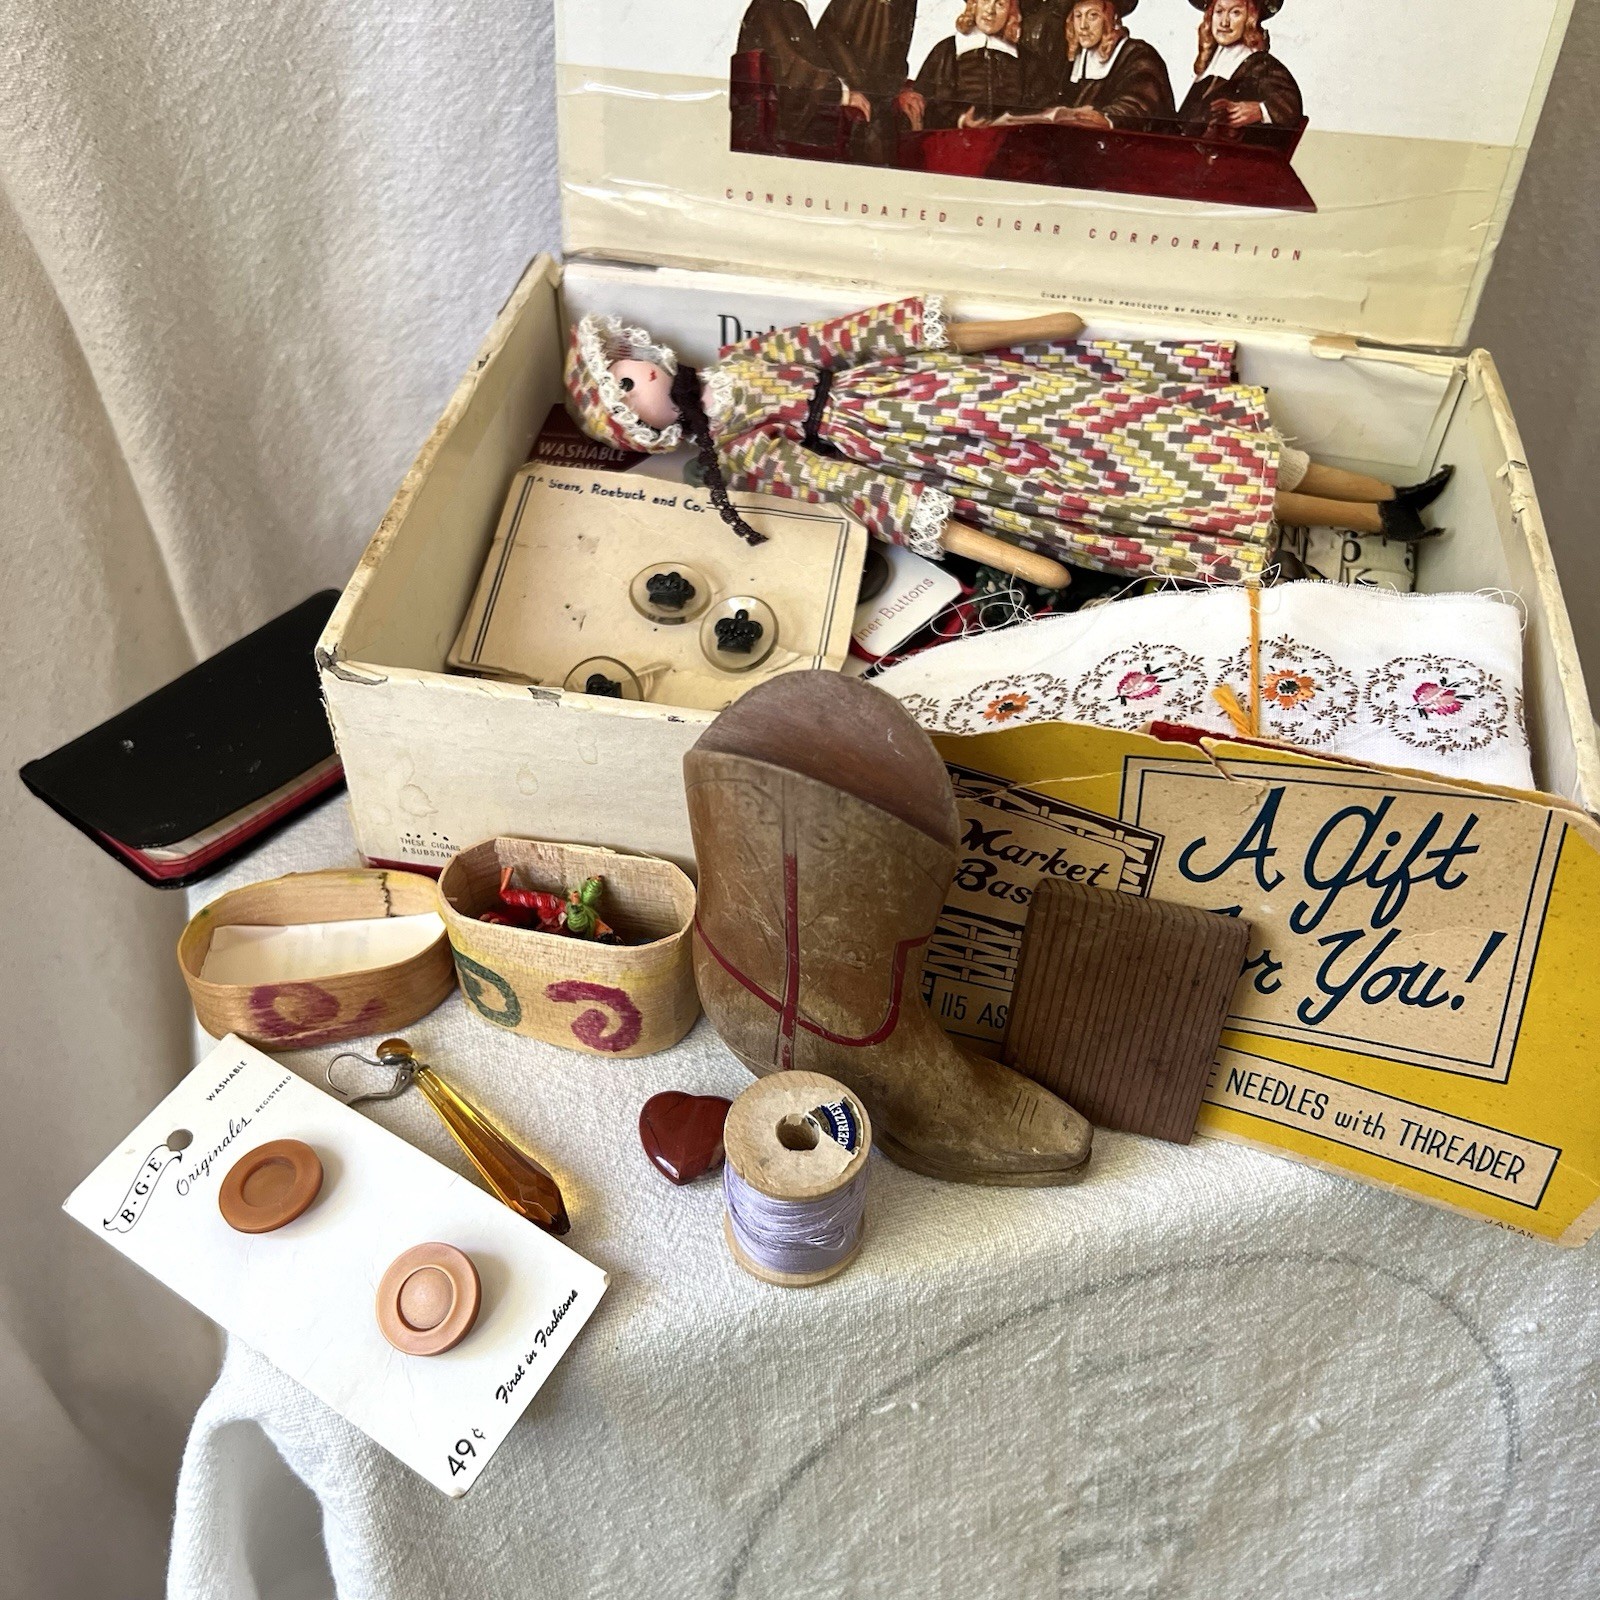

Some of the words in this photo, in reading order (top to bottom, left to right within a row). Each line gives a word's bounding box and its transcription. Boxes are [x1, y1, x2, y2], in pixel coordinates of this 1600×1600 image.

[725, 188, 947, 223] CONSOLIDATED
[976, 215, 1060, 235] CIGAR
[1088, 228, 1301, 261] CORPORATION
[538, 441, 627, 462] WASHABLE
[548, 478, 584, 494] Sears,
[590, 483, 646, 501] Roebuck
[652, 496, 676, 507] and
[683, 498, 706, 514] Co.
[878, 577, 935, 620] Buttons
[400, 837, 426, 847] THESE
[430, 841, 461, 852] CIGARS
[410, 847, 452, 858] SUBSTAN
[960, 818, 1110, 887] Market
[1177, 787, 1285, 894] A
[1288, 795, 1480, 930] Gift
[952, 857, 1034, 907] Bas
[1294, 930, 1508, 1026] You!
[976, 1002, 1008, 1029] AS
[206, 1060, 248, 1102] WASHABLE
[176, 1116, 253, 1196] Originales
[255, 1075, 292, 1113] REGISTERED
[1225, 1067, 1329, 1120] NEEDLES
[1334, 1109, 1386, 1140] with
[1399, 1118, 1526, 1184] THREADER
[495, 1364, 526, 1404] First
[525, 1350, 538, 1365] in
[534, 1289, 578, 1348] Fashions
